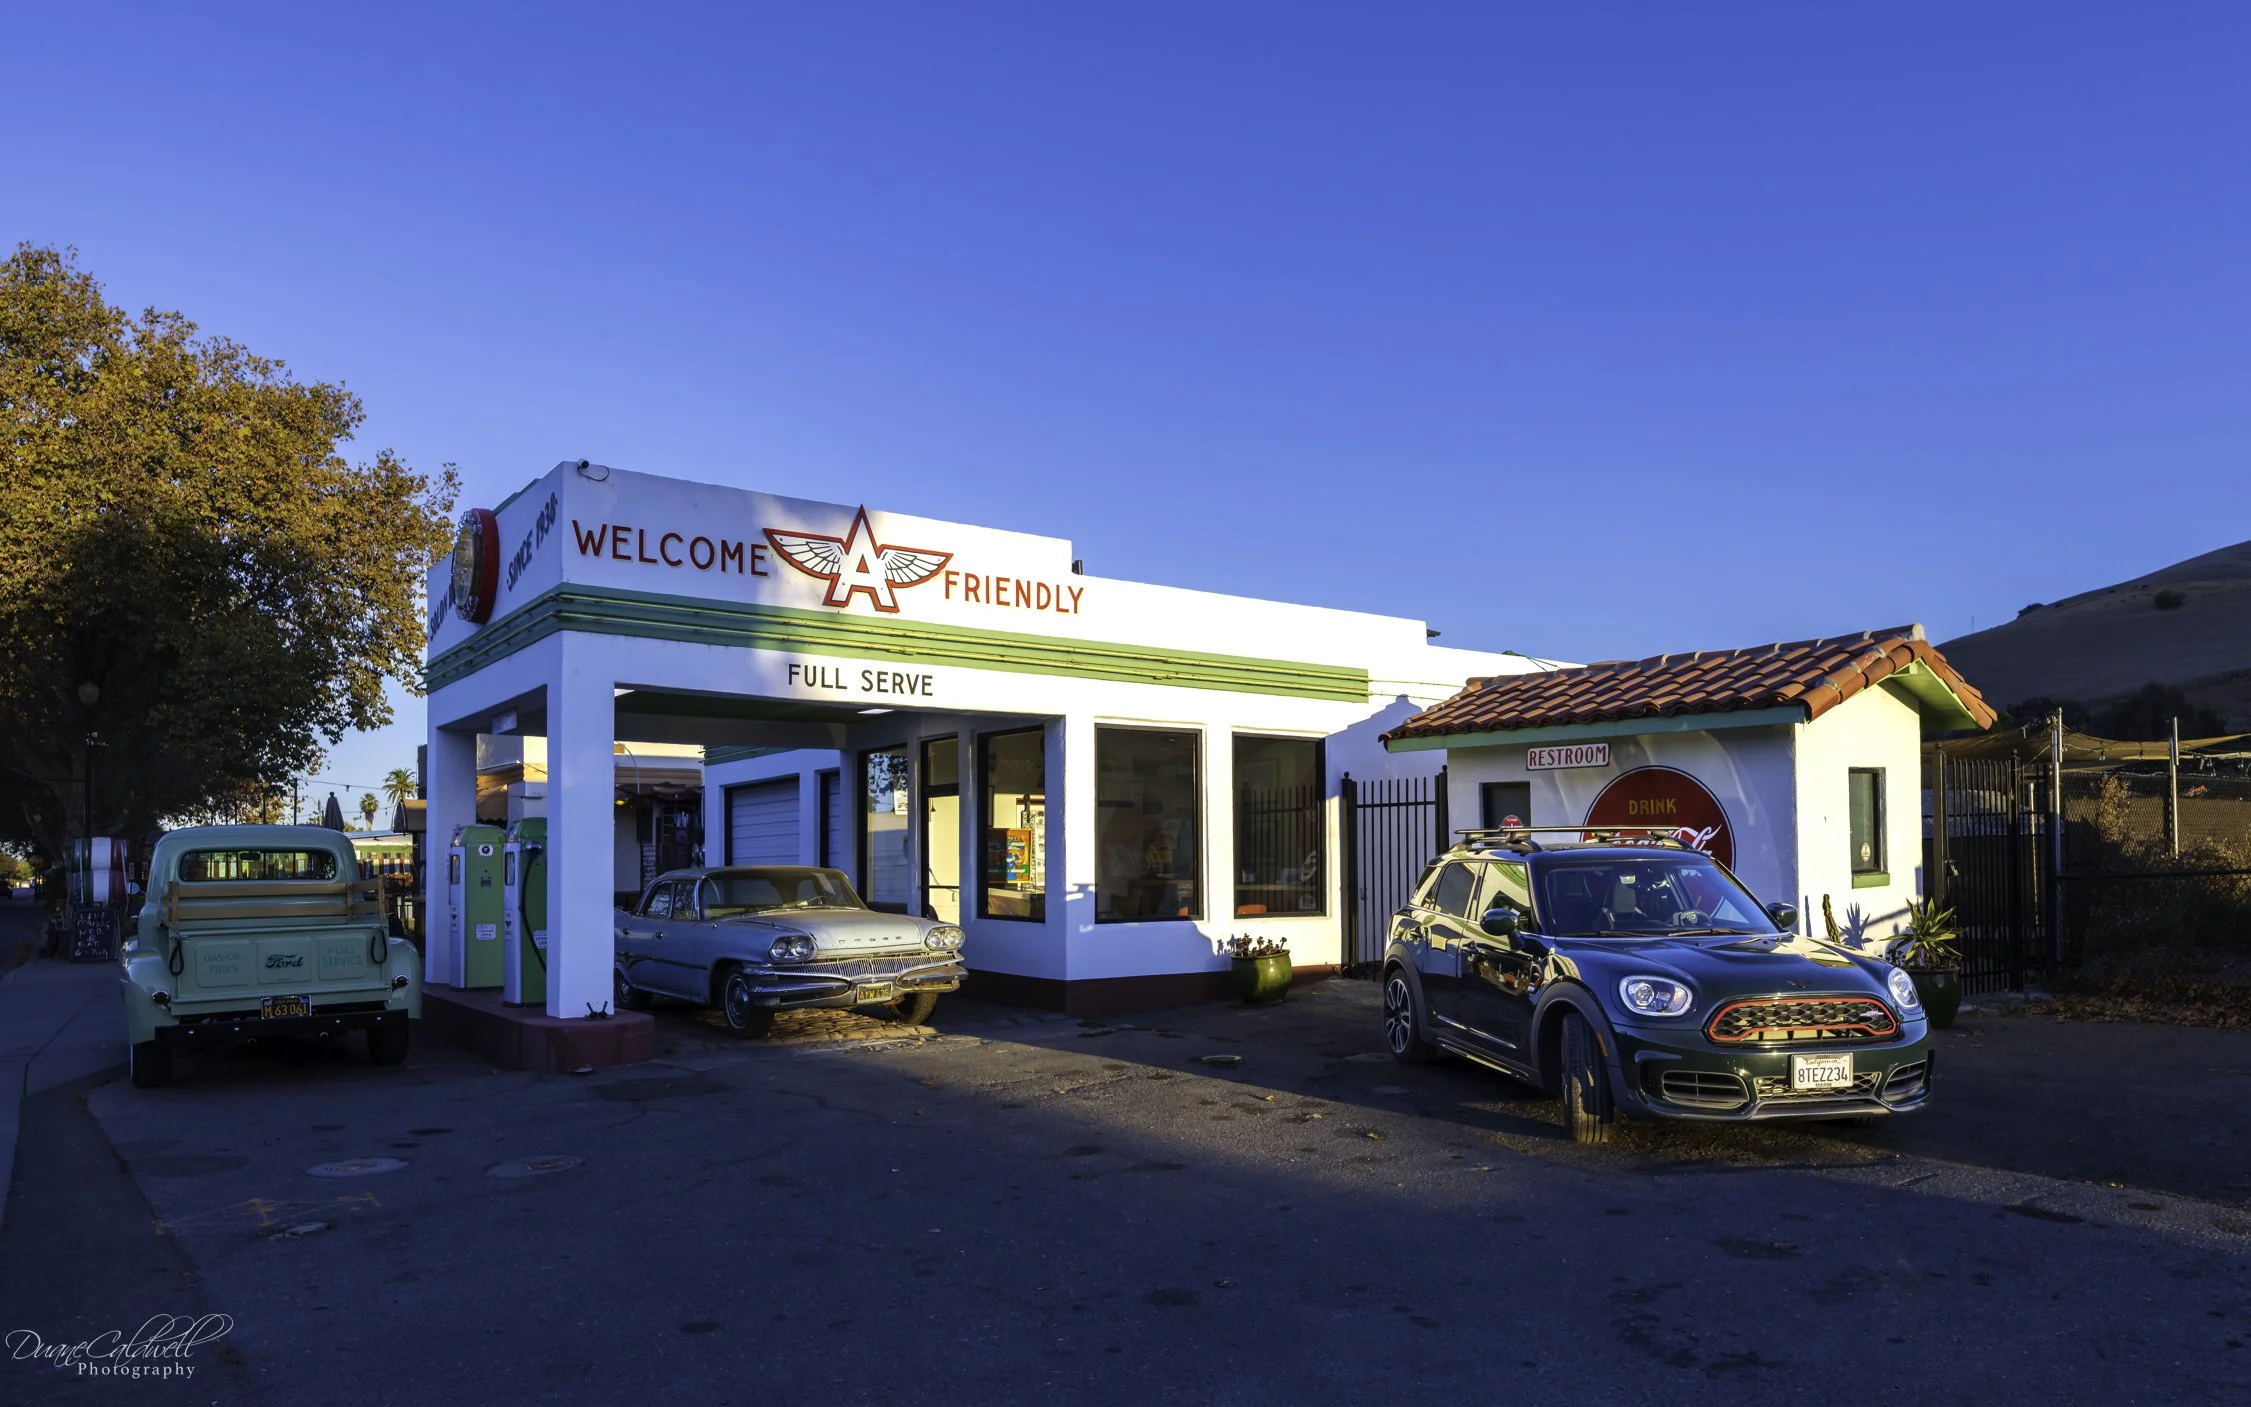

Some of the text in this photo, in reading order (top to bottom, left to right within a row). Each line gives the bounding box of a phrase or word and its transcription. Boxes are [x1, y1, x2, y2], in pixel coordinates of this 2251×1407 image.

[572, 519, 769, 578] WELCOME
[507, 528, 533, 593] SINCE
[944, 569, 1084, 614] FRIENDLY
[788, 663, 933, 697] FULL SERVE
[1529, 745, 1607, 767] RESTROOM
[1628, 797, 1677, 816] DRINK
[327, 945, 358, 955] FULL
[208, 963, 239, 974] TIRES
[265, 954, 304, 969] Ford
[321, 954, 364, 967] SERVICE
[1798, 1066, 1848, 1083] 8TEZ234
